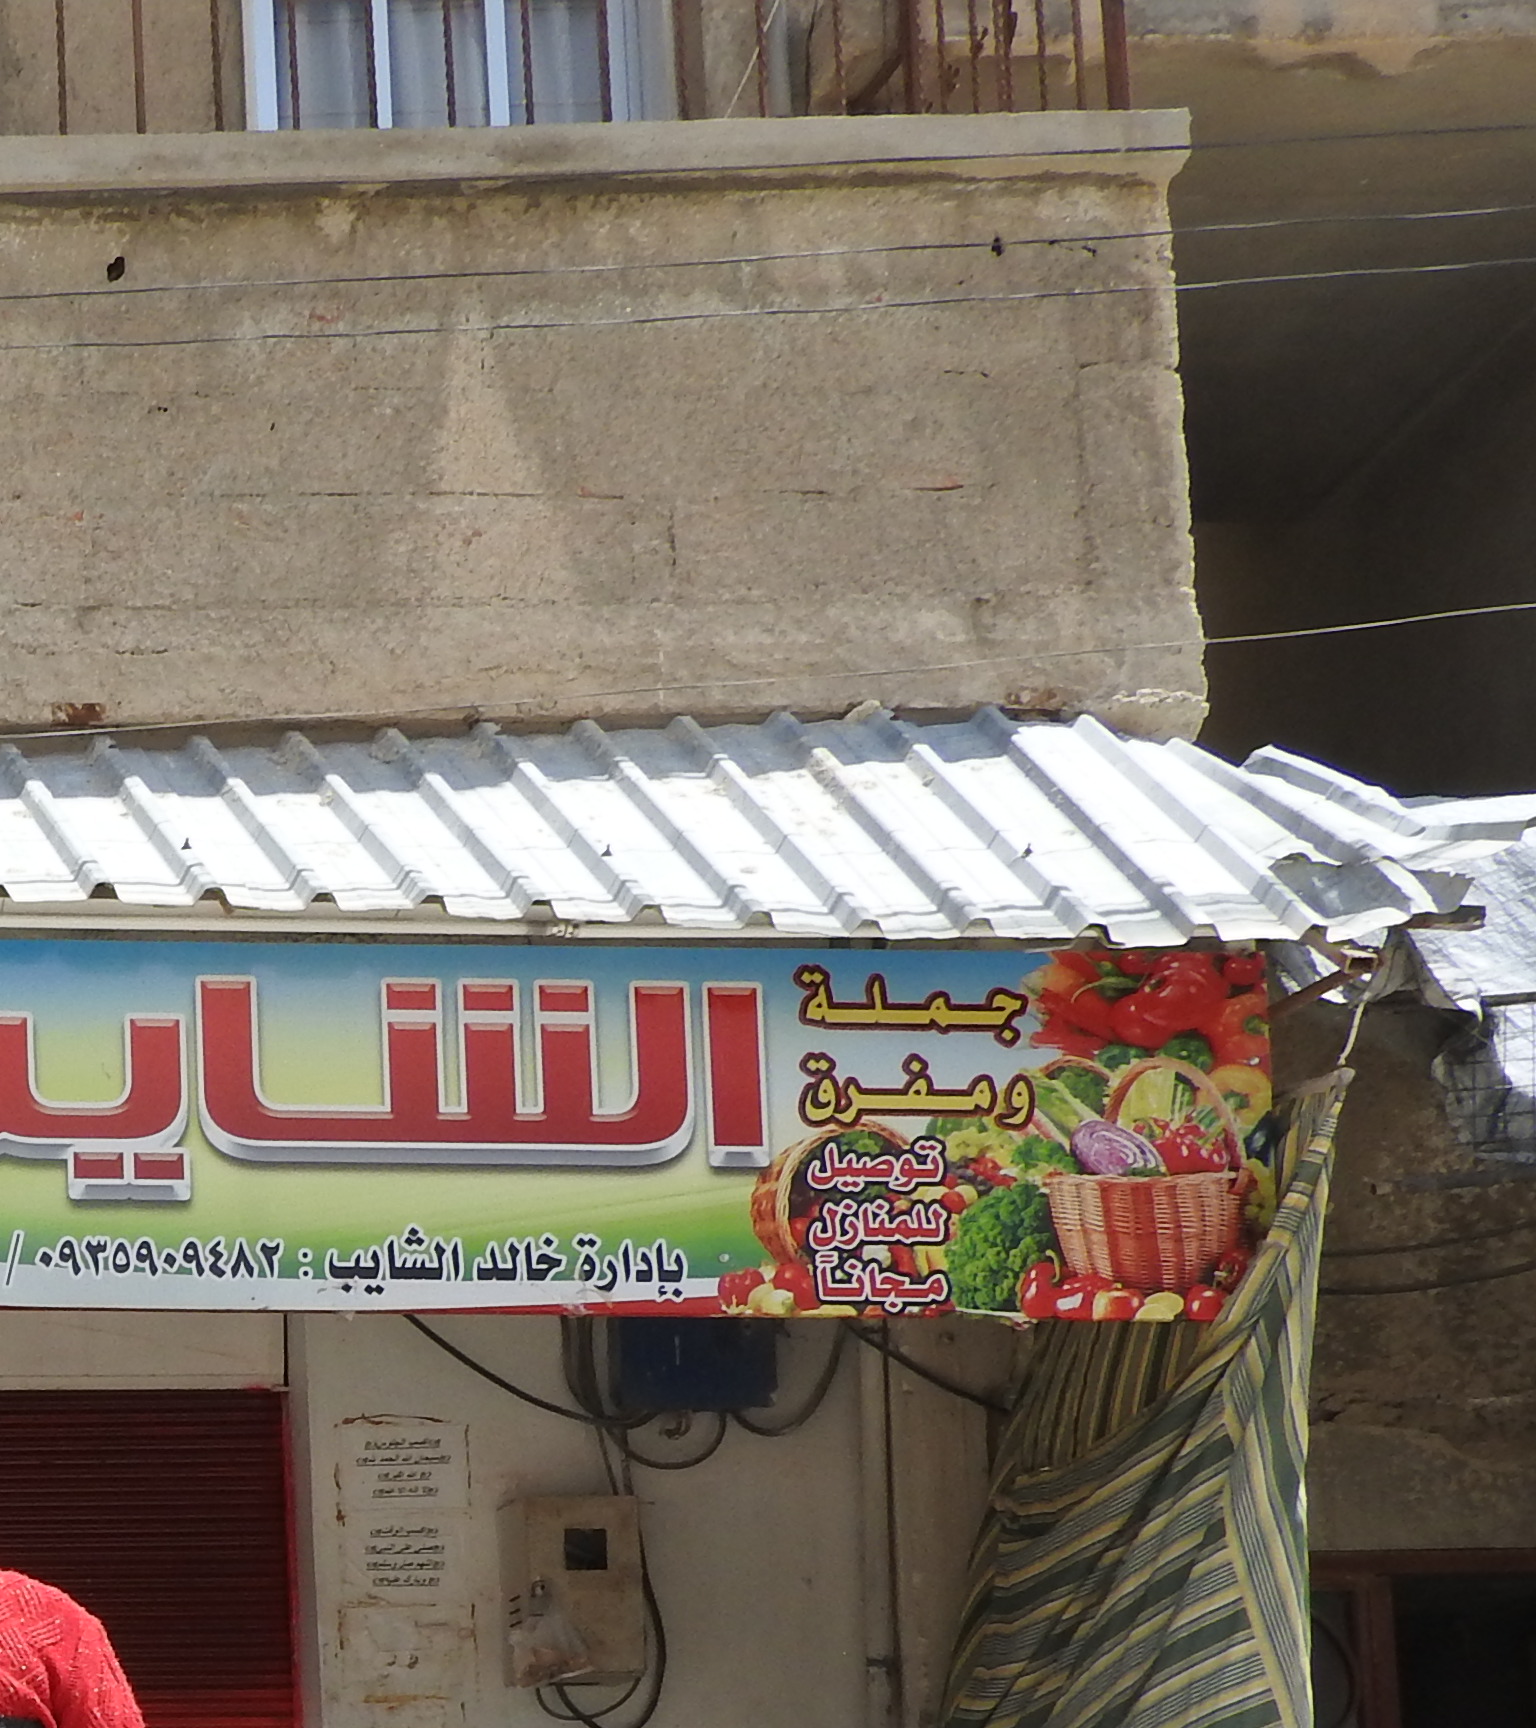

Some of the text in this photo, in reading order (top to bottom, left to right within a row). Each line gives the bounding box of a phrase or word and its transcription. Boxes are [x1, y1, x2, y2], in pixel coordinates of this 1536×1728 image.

[794, 964, 1027, 1047] جملة
[798, 1052, 1035, 1129] ومفرق
[808, 1140, 944, 1192] توصيل
[809, 1199, 947, 1250] للمنازل
[38, 1238, 282, 1279] ٠٩٣٥٩٠٩٤٨٢
[329, 1226, 460, 1295] الشايب
[477, 1236, 564, 1281] خالد
[580, 1238, 685, 1300] بإدارة
